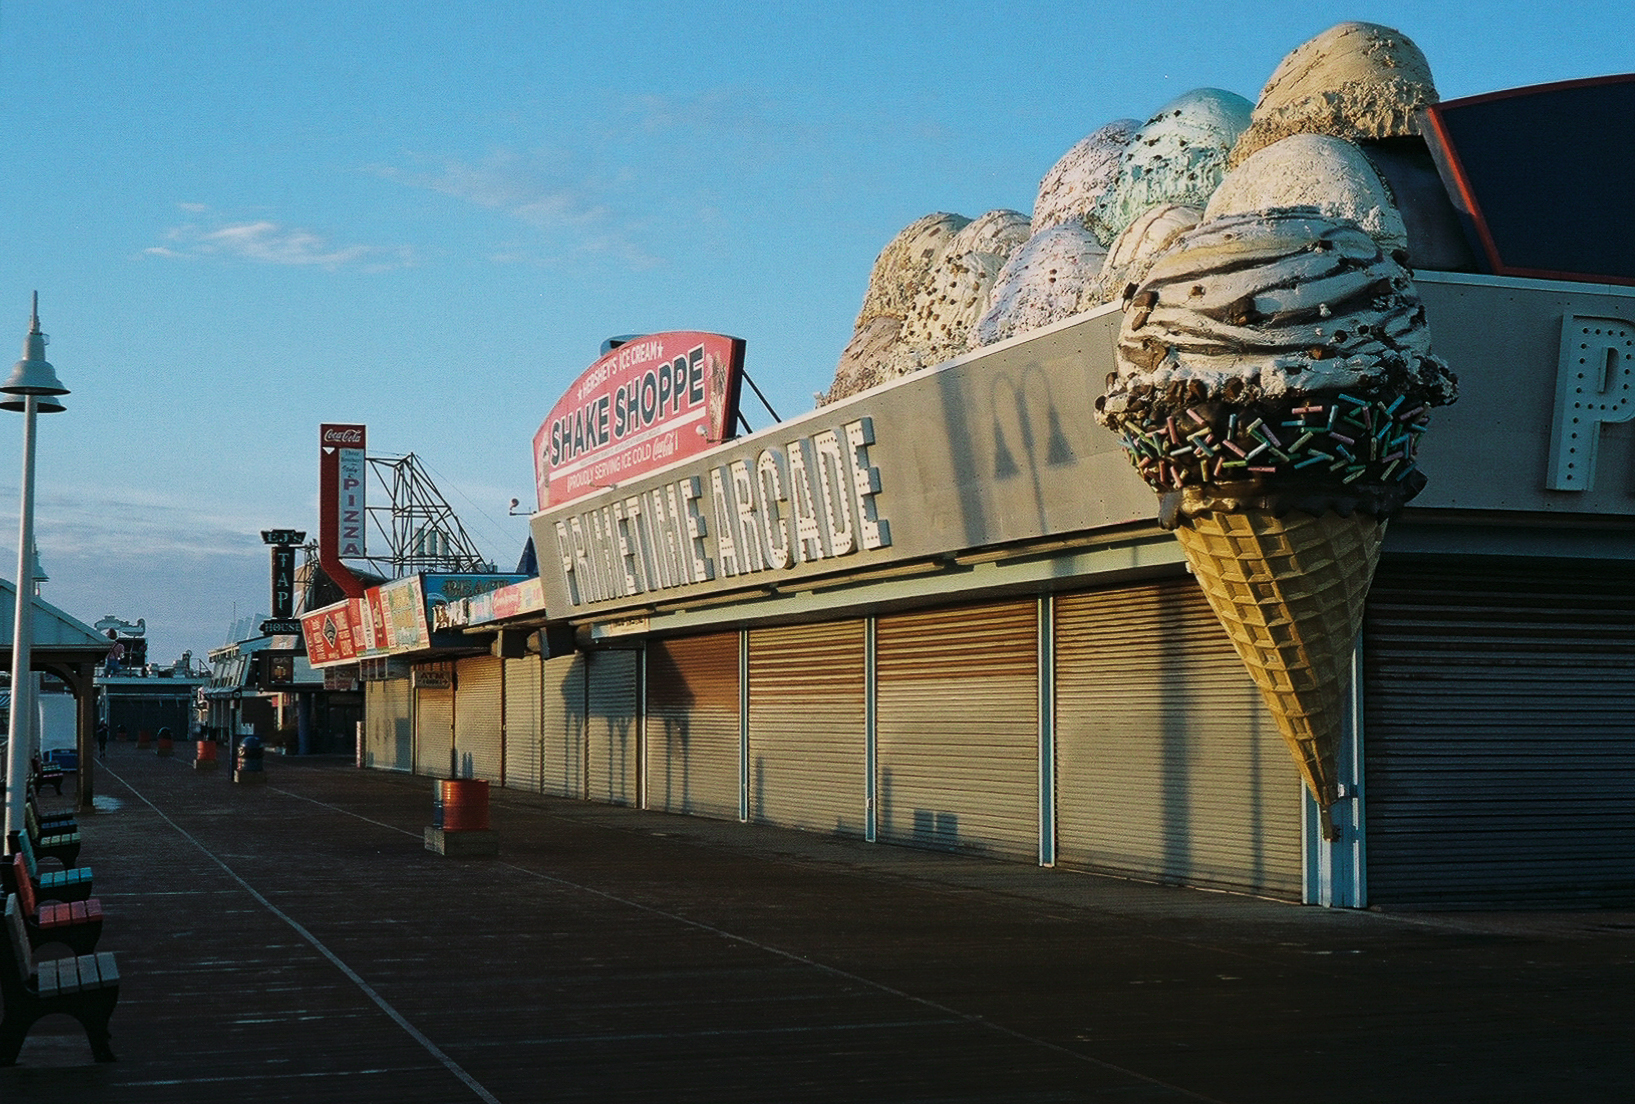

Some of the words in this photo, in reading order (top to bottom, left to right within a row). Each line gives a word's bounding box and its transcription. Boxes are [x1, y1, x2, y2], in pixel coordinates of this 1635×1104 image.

[582, 356, 618, 398] HERSHEY'S
[619, 348, 631, 371] ICE
[631, 341, 657, 365] CREAM
[550, 392, 610, 468] SHAKE
[614, 343, 705, 440] SHOPPE
[570, 465, 594, 490] PROUDLY
[595, 455, 620, 480] SERVING
[621, 451, 632, 469] ICE
[632, 443, 651, 464] COLD
[342, 478, 361, 556] PIZZA
[711, 416, 892, 578] ARCADE
[276, 552, 290, 611] TAP
[264, 622, 301, 632] HOUSE
